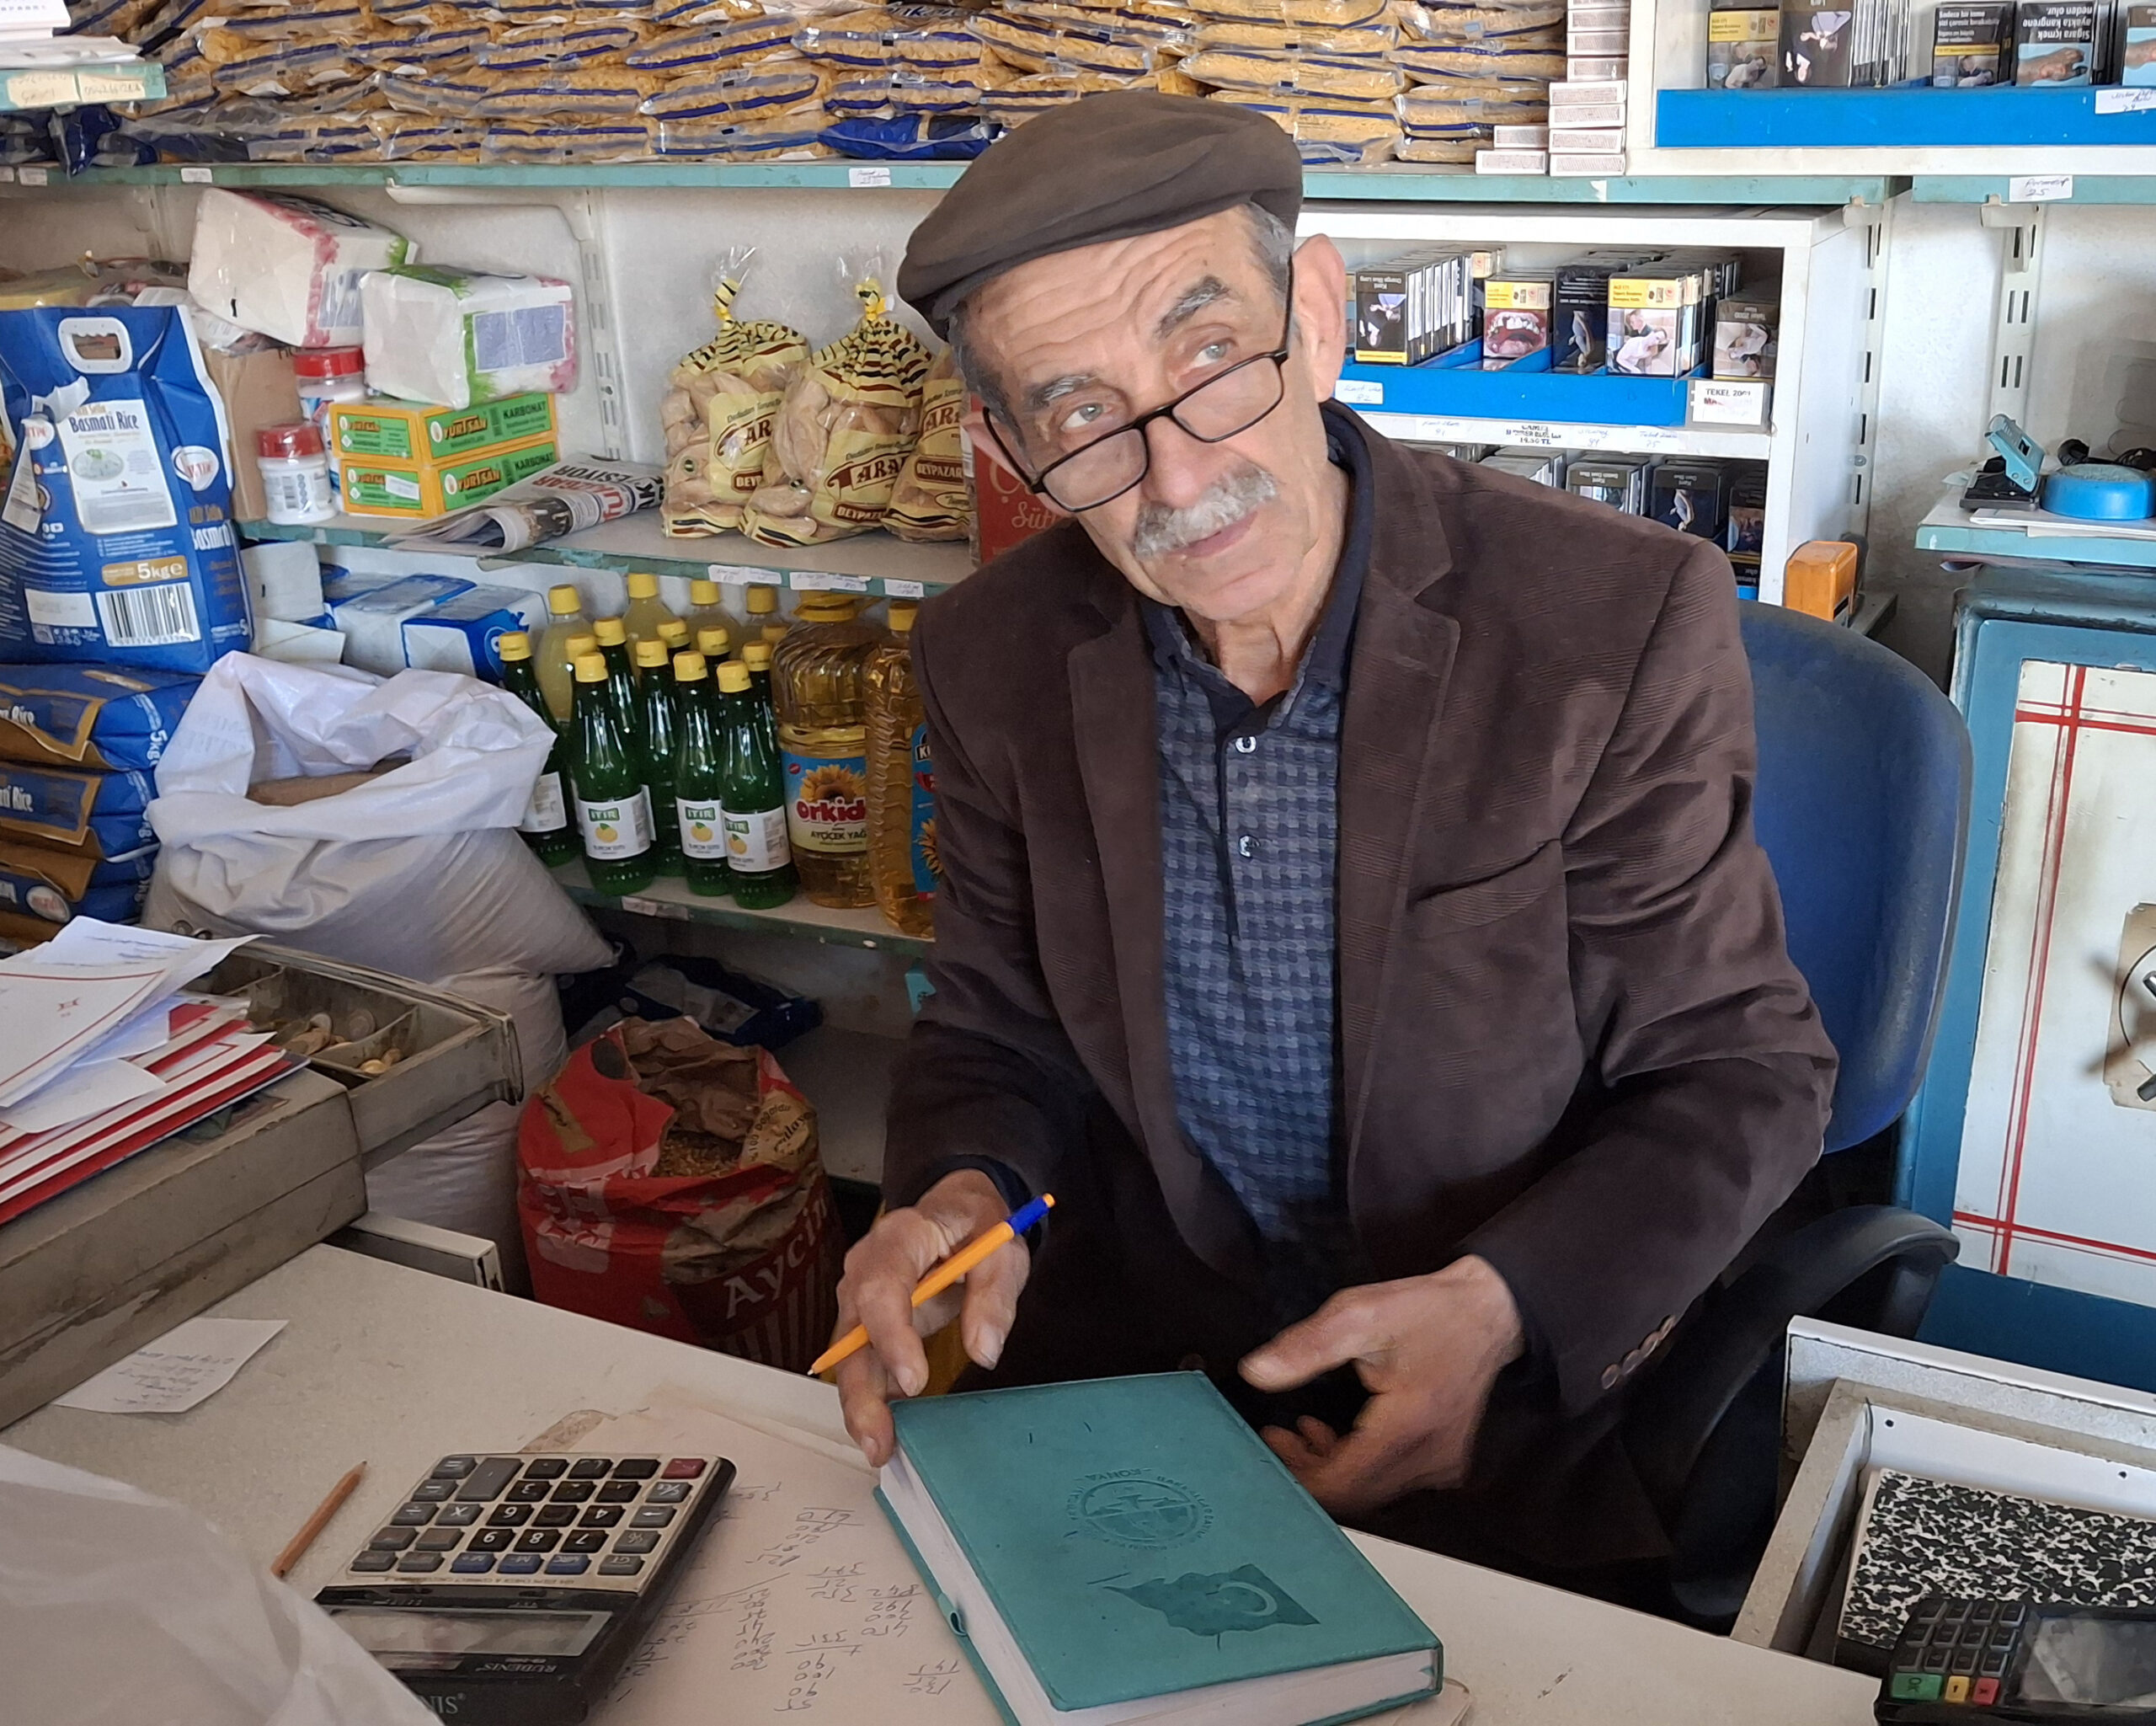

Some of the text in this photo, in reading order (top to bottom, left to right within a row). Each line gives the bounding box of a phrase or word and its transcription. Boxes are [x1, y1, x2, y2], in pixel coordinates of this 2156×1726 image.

[2066, 6, 2092, 16] neden
[2023, 17, 2091, 29] ayakta kangrene
[2064, 28, 2090, 40] Sigara
[1705, 388, 1730, 397] TEKEL
[503, 400, 547, 419] KARBONAT
[68, 412, 115, 433] Basmati
[115, 411, 139, 430] Rice
[443, 414, 488, 441] YURTSAN
[514, 452, 554, 471] KARBONAT
[457, 467, 501, 491] YURTSAN
[11, 706, 35, 726] Rice
[13, 786, 34, 812] Rice
[797, 796, 867, 823] Orkid
[504, 1506, 517, 1519] 6
[595, 1508, 610, 1519] 4
[483, 1531, 496, 1545] 9
[531, 1531, 543, 1545] 8
[575, 1531, 590, 1546] 7
[809, 1587, 857, 1603] 350
[861, 1623, 909, 1637] 450
[797, 1654, 825, 1669] 90
[794, 1666, 835, 1681] 100
[790, 1683, 819, 1697] 90
